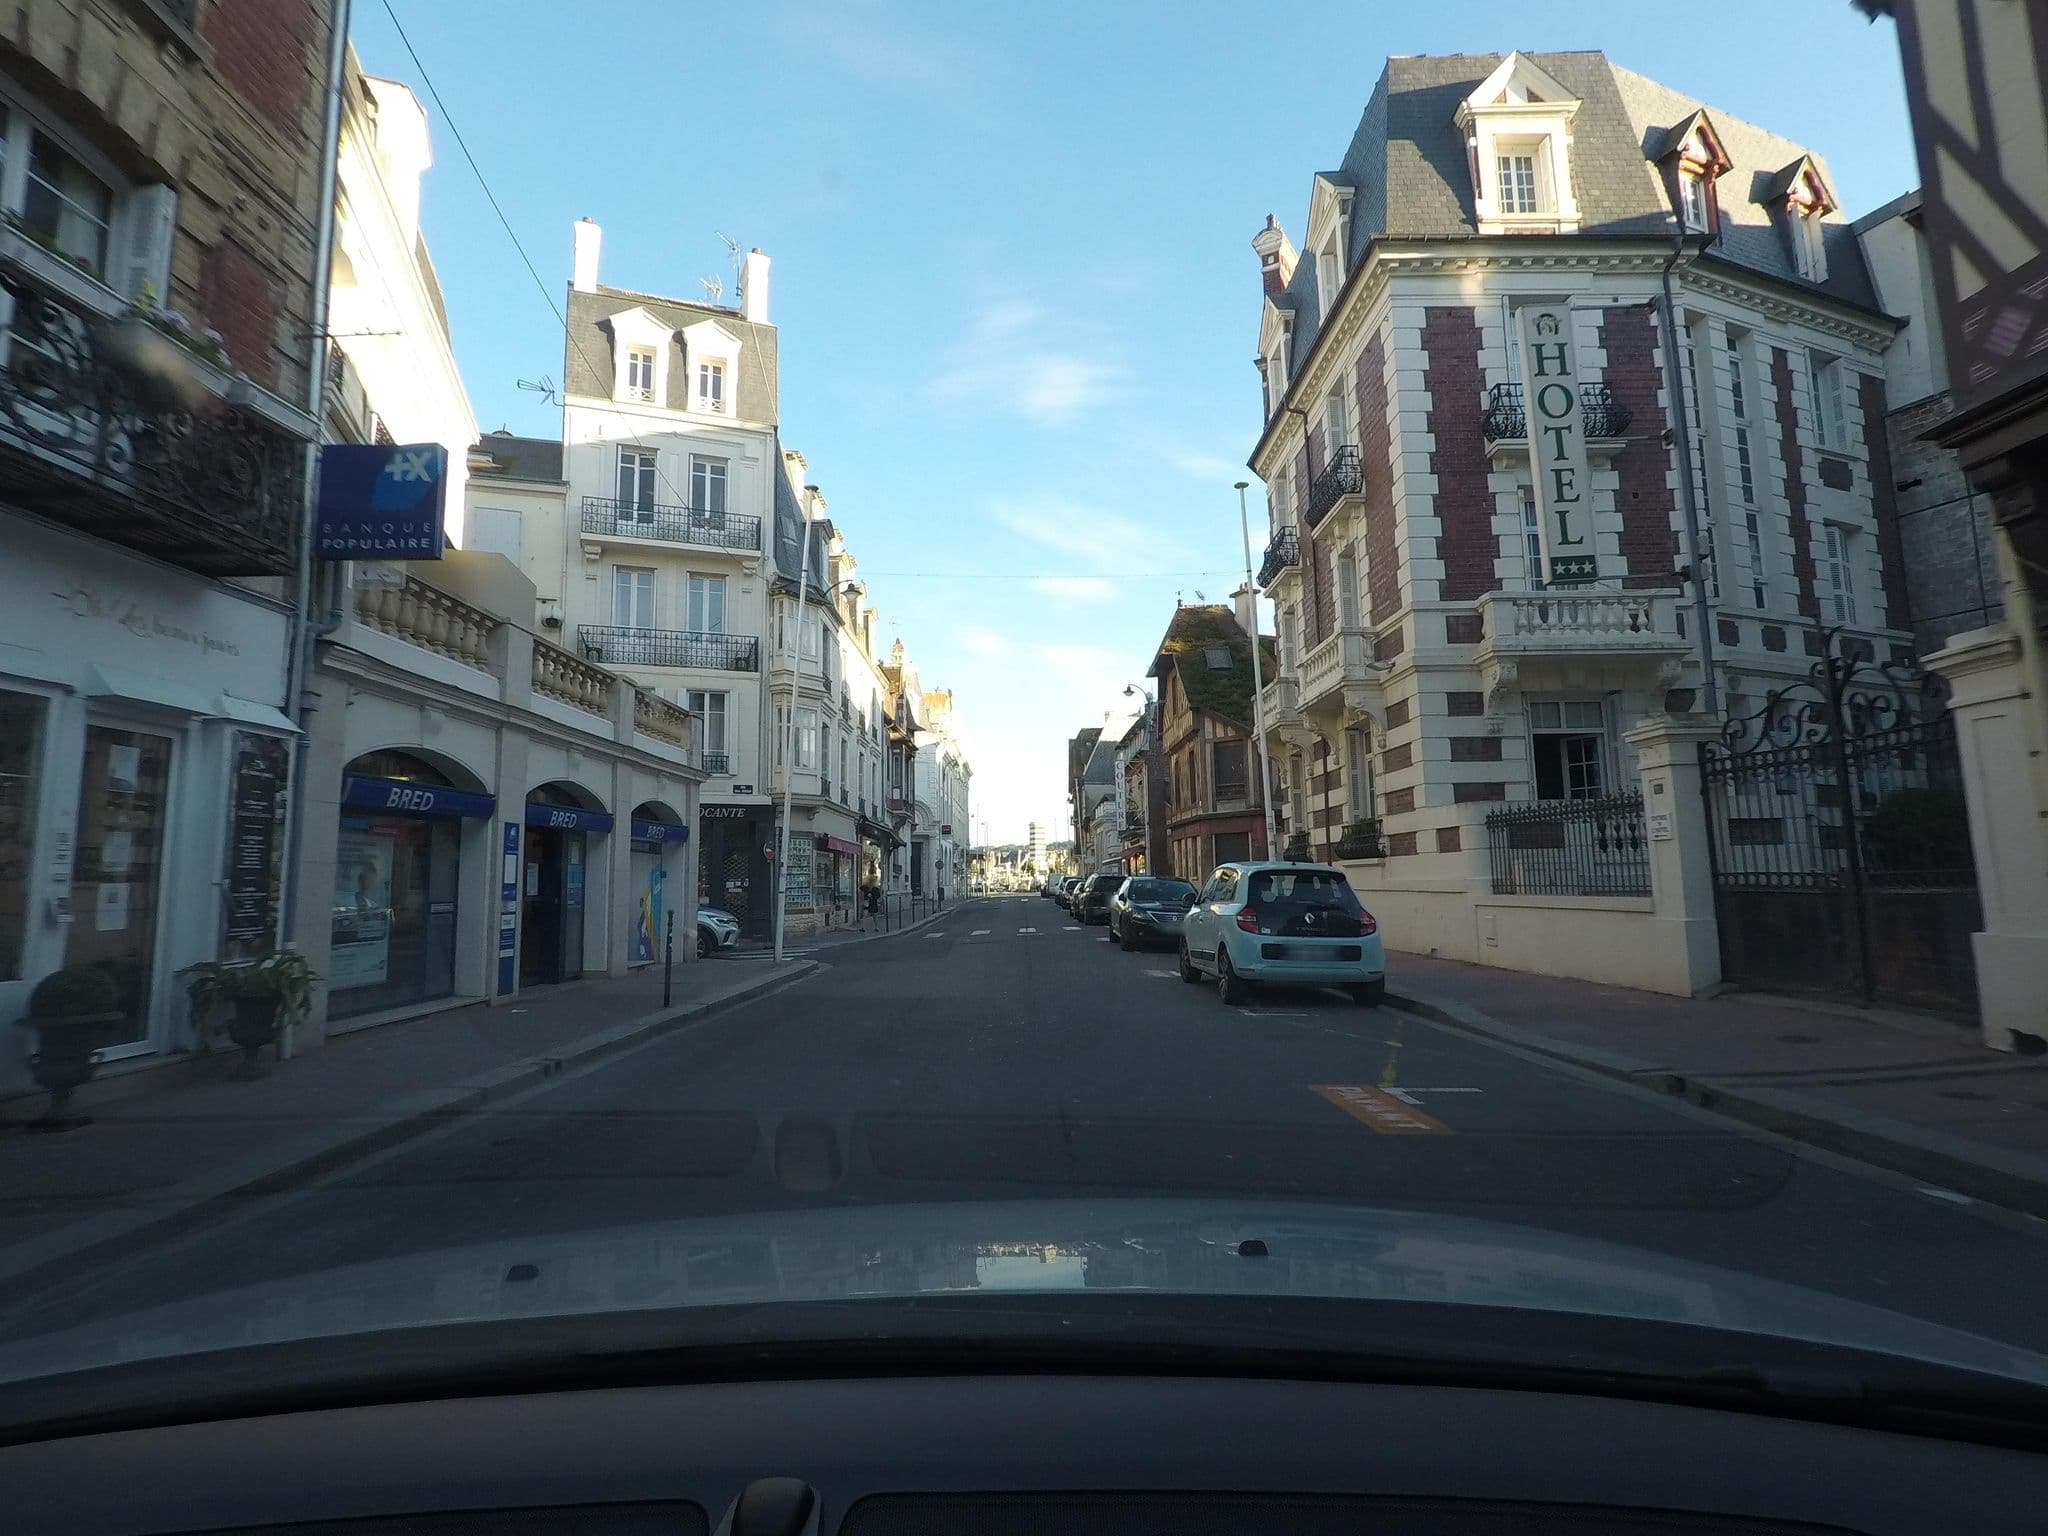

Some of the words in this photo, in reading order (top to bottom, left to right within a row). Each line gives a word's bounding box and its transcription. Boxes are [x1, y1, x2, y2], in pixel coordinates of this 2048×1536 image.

[1531, 342, 1584, 546] HOTEL
[322, 521, 433, 533] BANQUE
[321, 537, 431, 550] POPULAIRE
[386, 787, 435, 812] BRED
[549, 810, 577, 829] BRED
[646, 825, 665, 839] BRED
